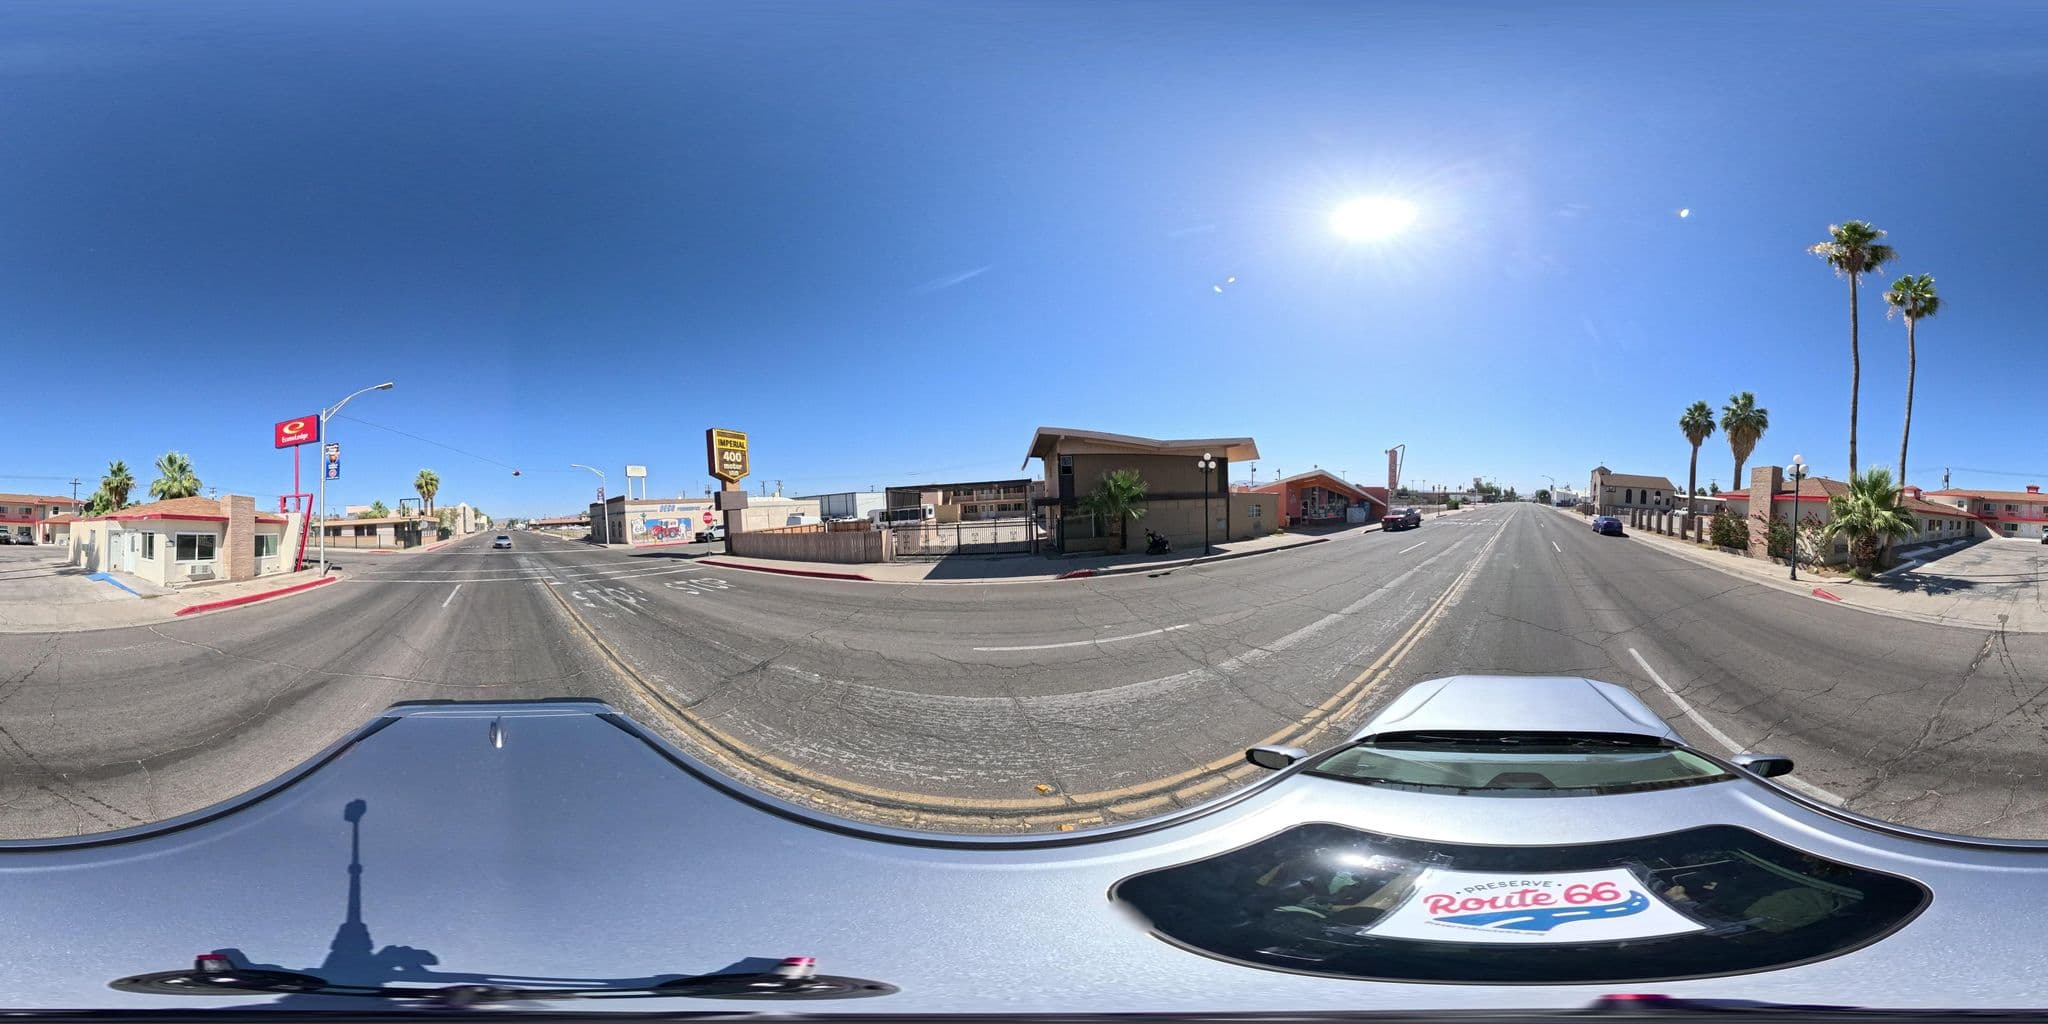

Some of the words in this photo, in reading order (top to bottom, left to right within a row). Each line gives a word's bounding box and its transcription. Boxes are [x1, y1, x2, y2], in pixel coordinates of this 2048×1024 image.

[718, 438, 745, 449] IMPERIAL
[723, 451, 742, 462] 400
[1464, 880, 1552, 894] PRESERVE
[1423, 889, 1558, 915] Route
[1564, 881, 1621, 904] 66
